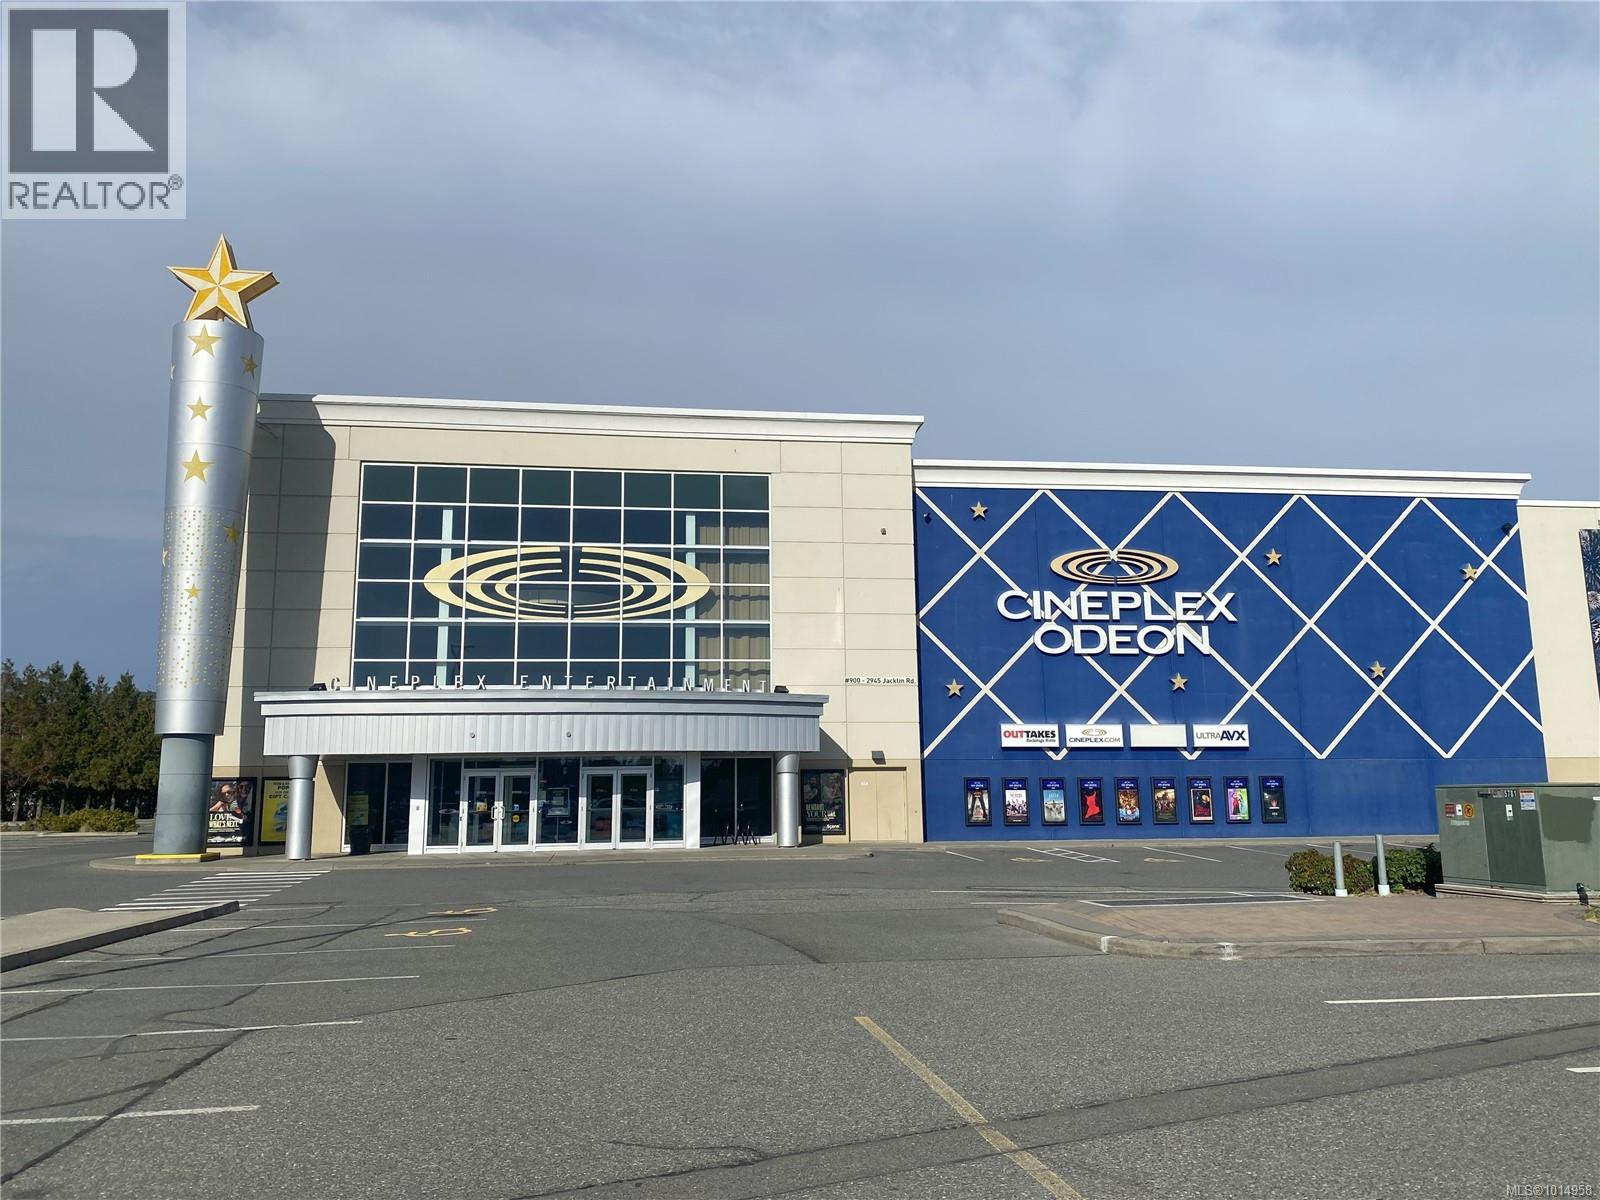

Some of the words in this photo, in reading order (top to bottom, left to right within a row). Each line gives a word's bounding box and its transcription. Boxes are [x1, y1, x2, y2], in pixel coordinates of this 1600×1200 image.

[997, 590, 1237, 621] CINEPLEX
[1034, 625, 1211, 655] ODEON
[519, 675, 767, 694] ENTERTAINMENT
[845, 677, 860, 685] #900
[1003, 730, 1056, 739] OUTTAKES
